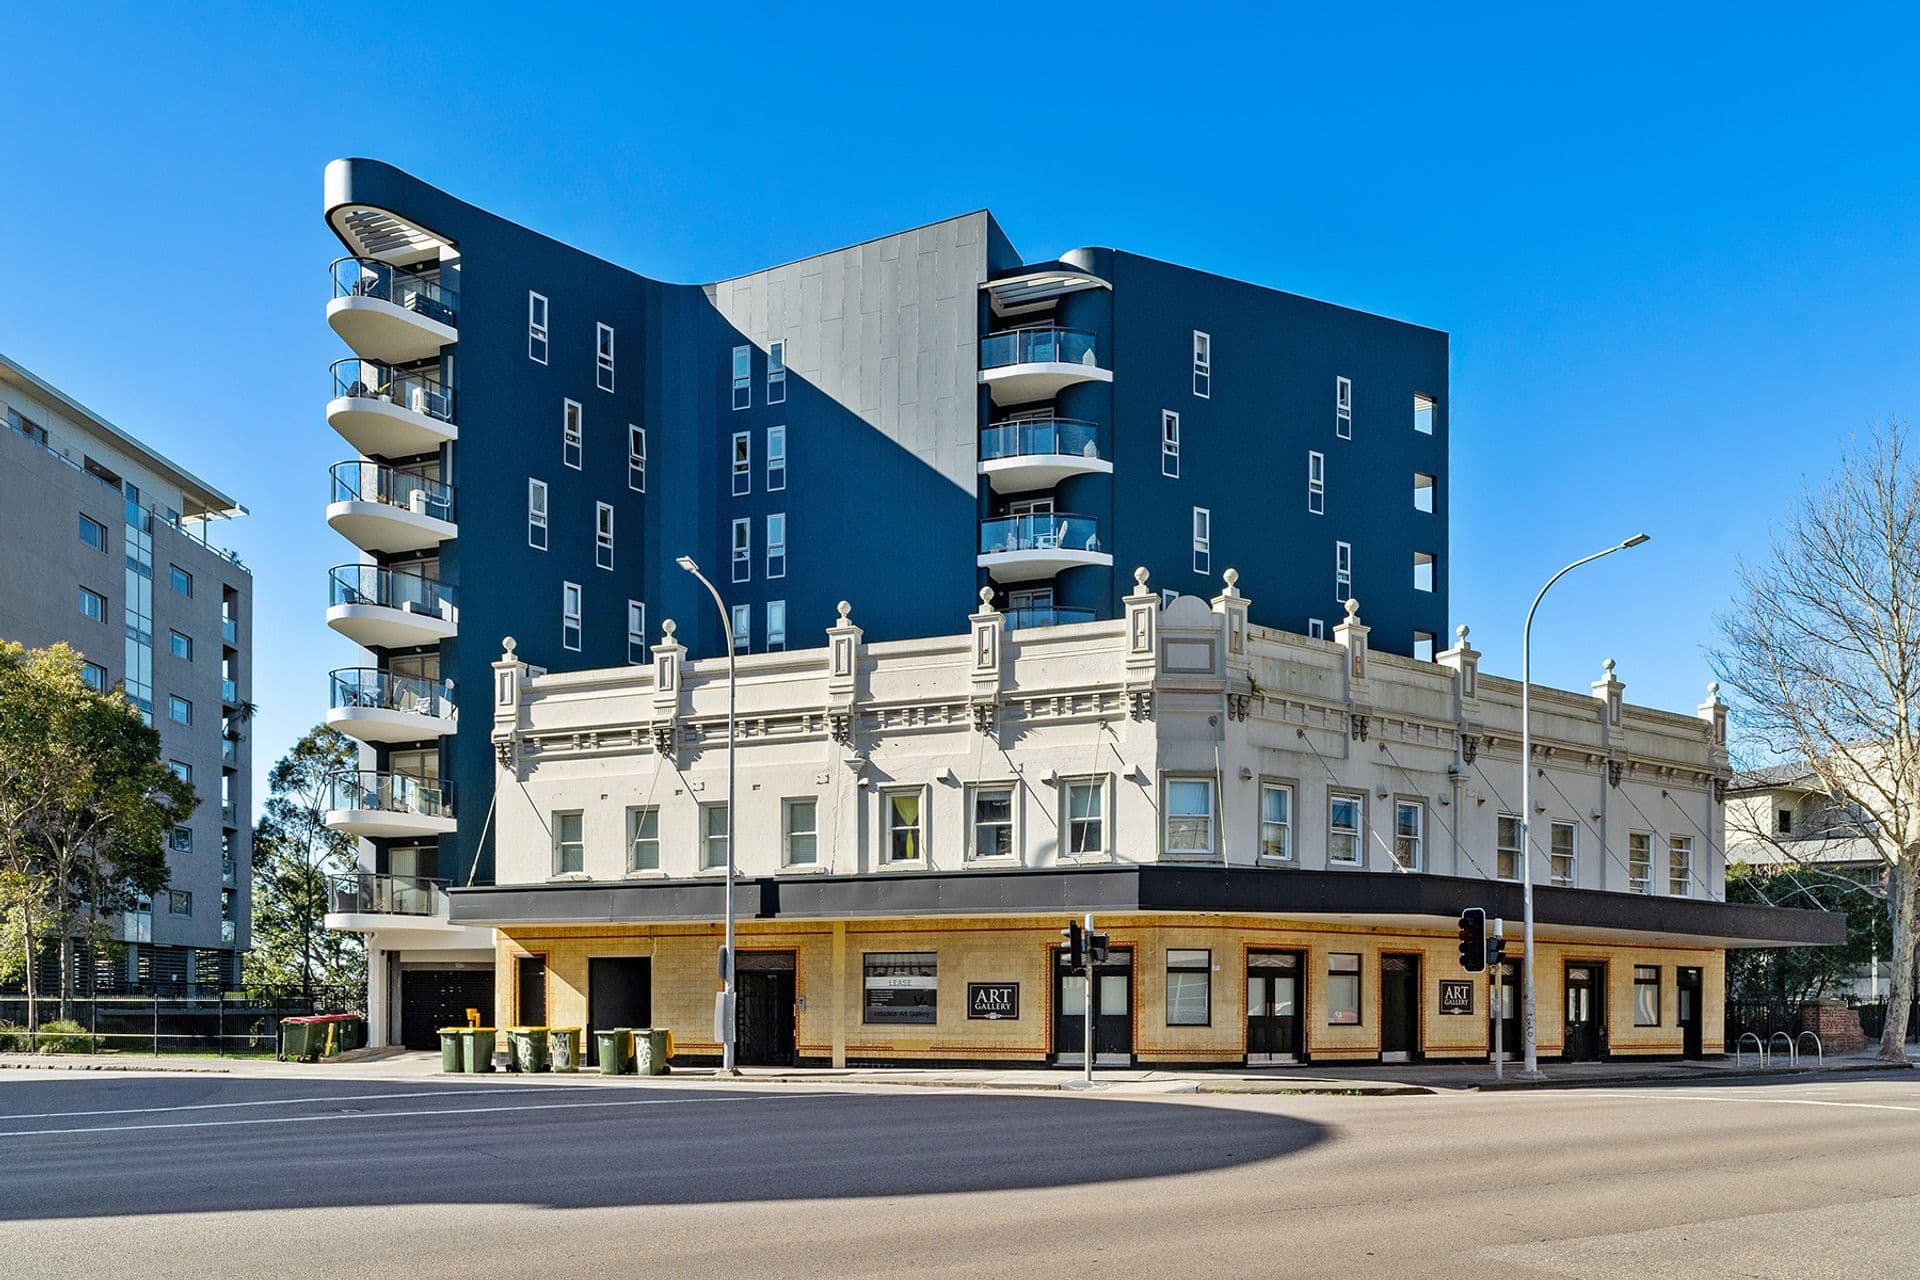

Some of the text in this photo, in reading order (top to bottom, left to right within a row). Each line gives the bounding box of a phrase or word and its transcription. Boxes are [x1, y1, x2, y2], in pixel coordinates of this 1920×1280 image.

[888, 979, 912, 987] LEASE
[976, 989, 1012, 1003] ART
[1445, 985, 1469, 999] ART
[974, 1002, 1011, 1010] GALLERY
